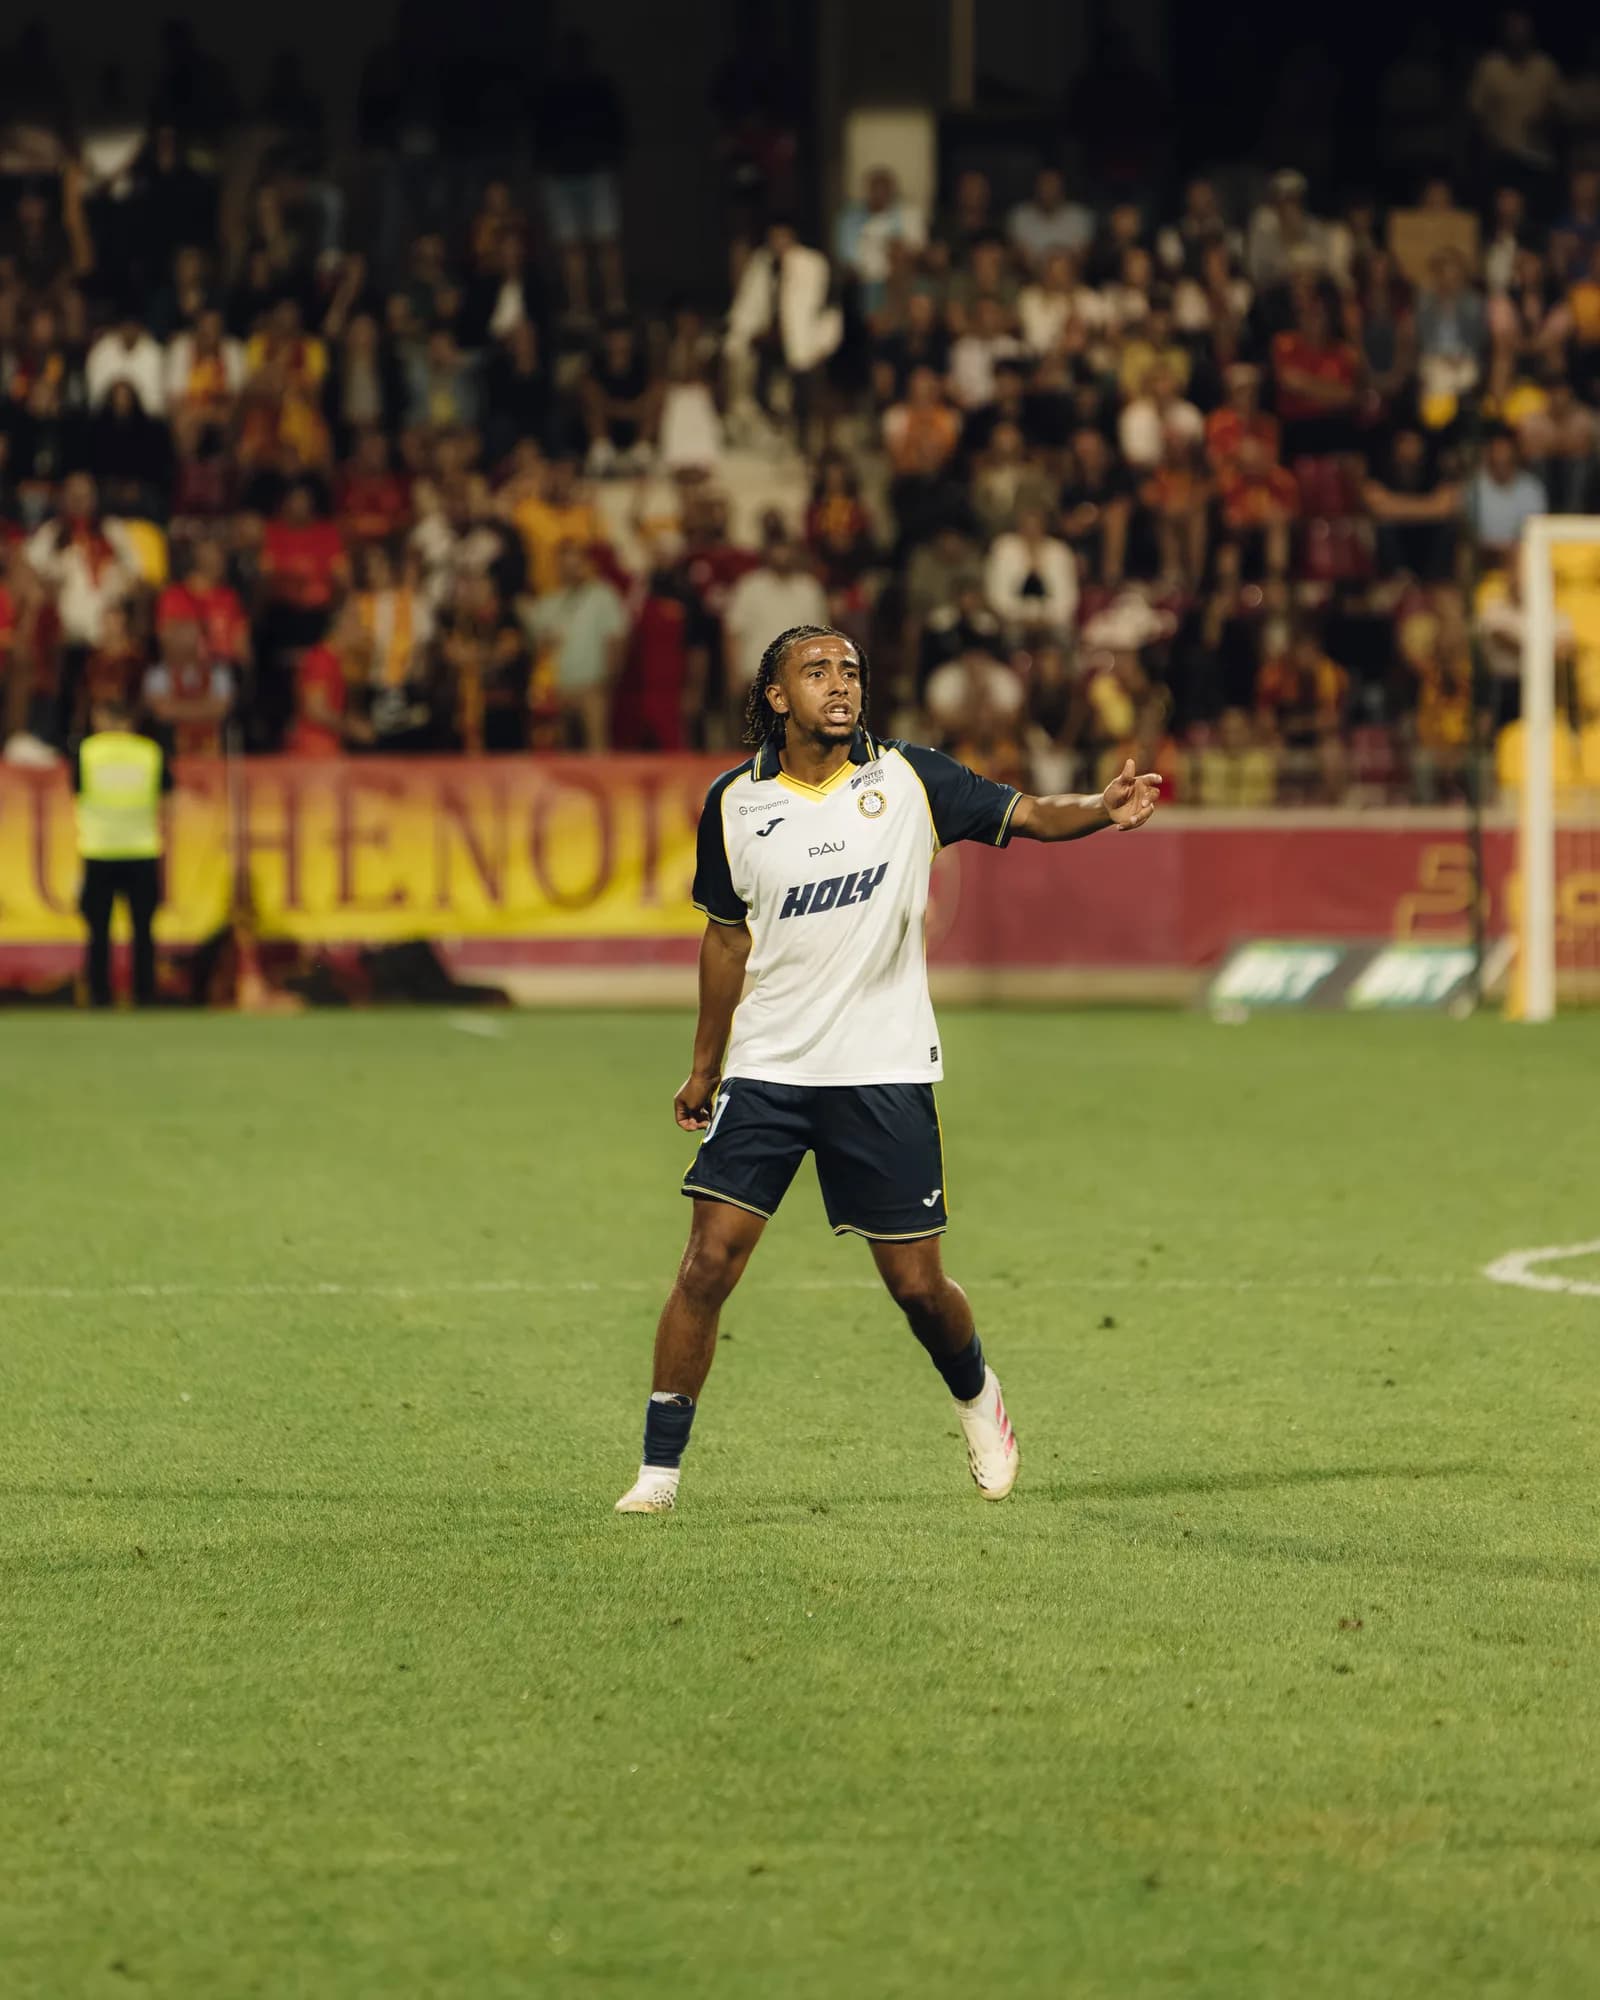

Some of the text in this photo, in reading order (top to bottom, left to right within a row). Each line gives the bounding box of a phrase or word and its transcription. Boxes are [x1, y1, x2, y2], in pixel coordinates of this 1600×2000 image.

[749, 799, 790, 813] Groupama
[808, 840, 846, 858] PAU
[778, 861, 889, 920] HOLY
